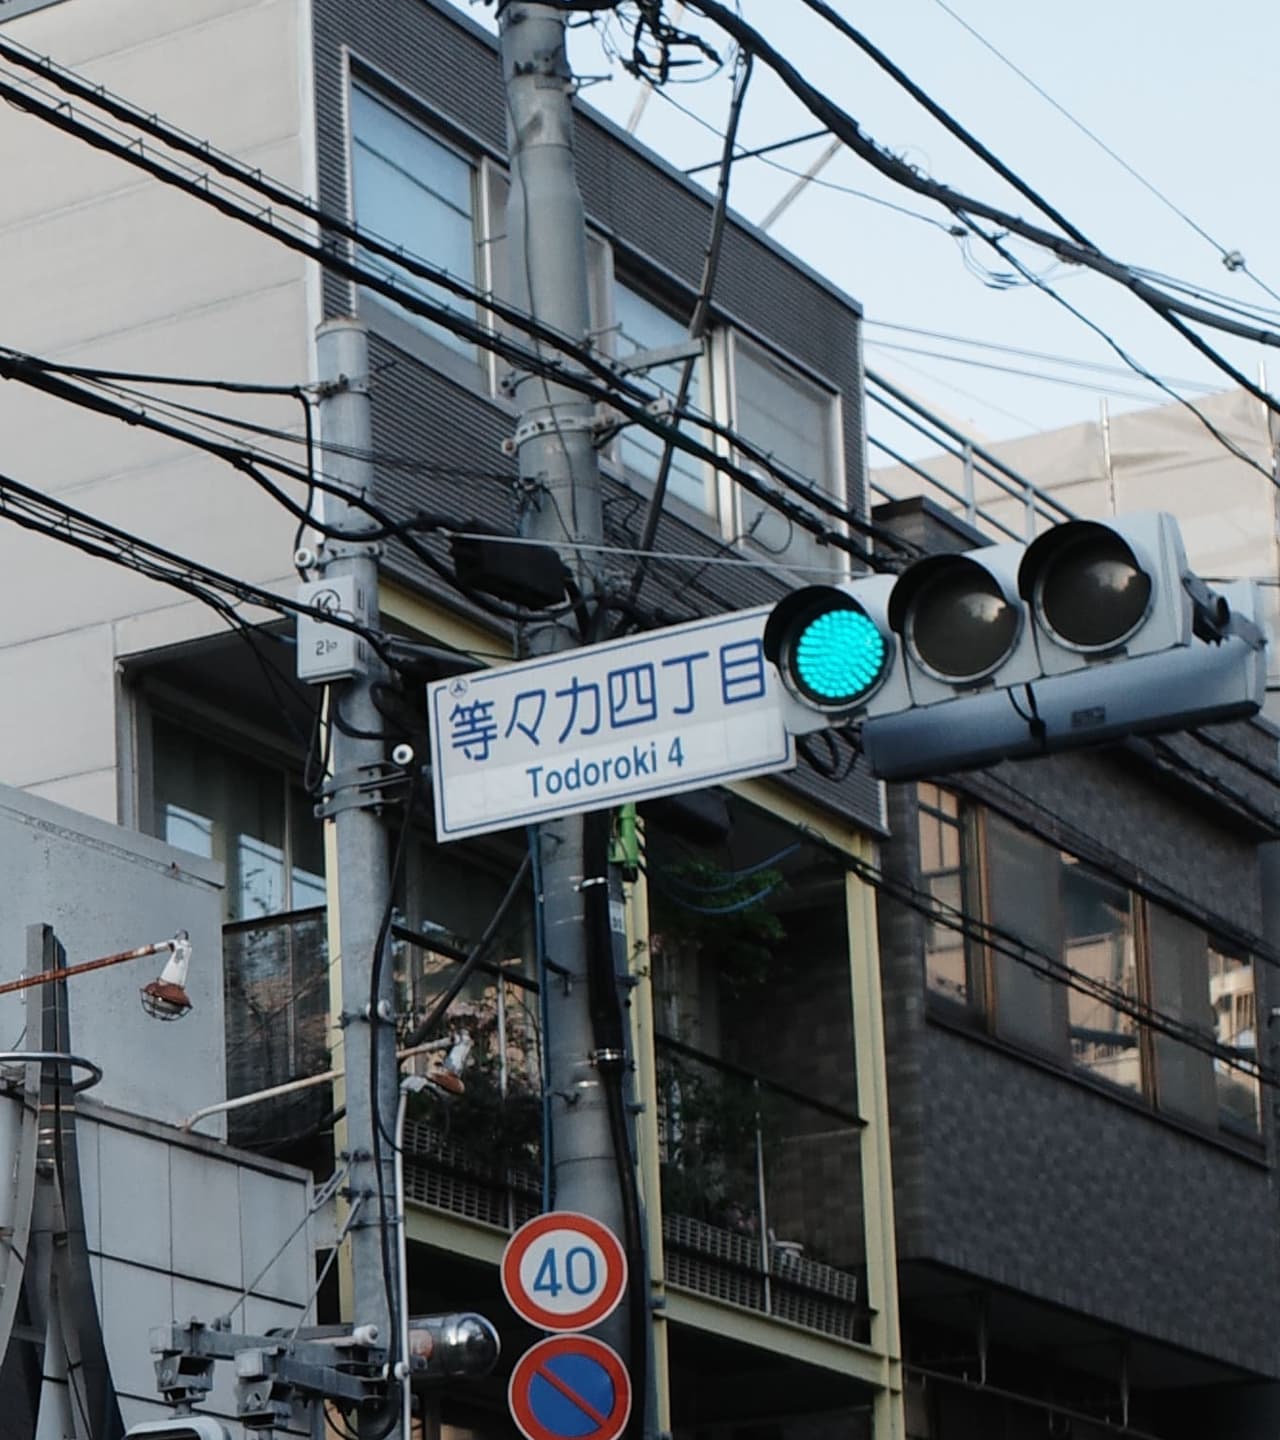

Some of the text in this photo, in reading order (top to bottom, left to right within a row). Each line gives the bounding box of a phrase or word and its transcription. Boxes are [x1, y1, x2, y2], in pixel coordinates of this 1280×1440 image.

[449, 638, 767, 761] 等々力四丁目
[526, 736, 685, 798] Todoroki 4
[532, 1246, 598, 1298] 40
